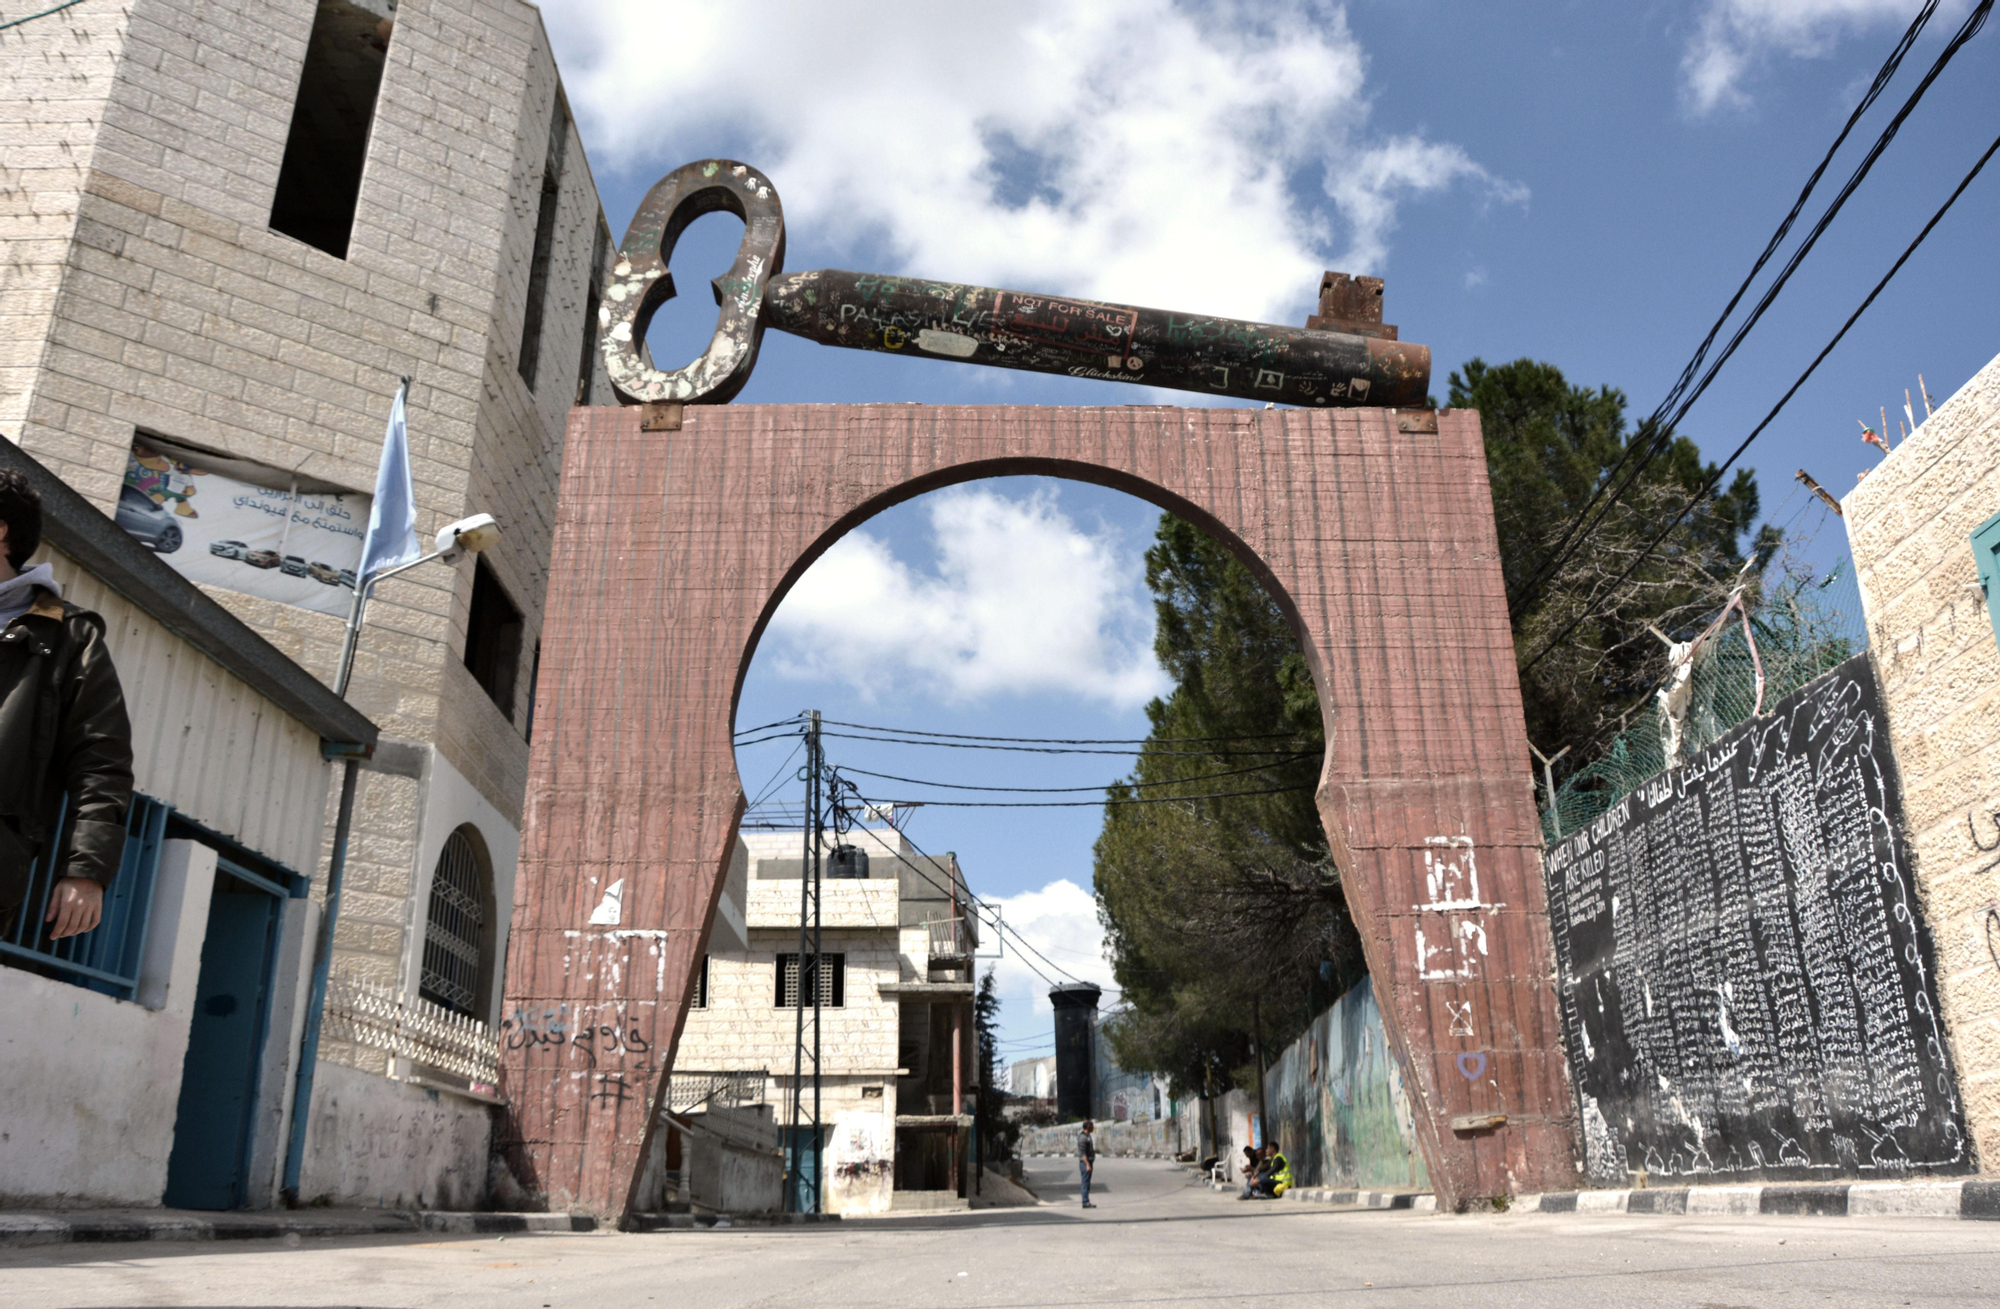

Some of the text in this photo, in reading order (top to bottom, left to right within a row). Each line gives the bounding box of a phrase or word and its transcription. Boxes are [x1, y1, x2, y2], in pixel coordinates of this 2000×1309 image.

[1009, 312, 1070, 334] للبيع
[1011, 295, 1126, 326] NOT FOR SALE
[1068, 365, 1145, 382] Glückskind
[233, 496, 365, 541] واستمتع مع هيونداي
[1706, 740, 1739, 773] عندما
[1677, 763, 1706, 799] يقتل
[1546, 799, 1630, 875] WHEN OUR CHILDREN
[1565, 849, 1605, 893] ARE KILLED
[573, 1015, 649, 1069] قاوم
